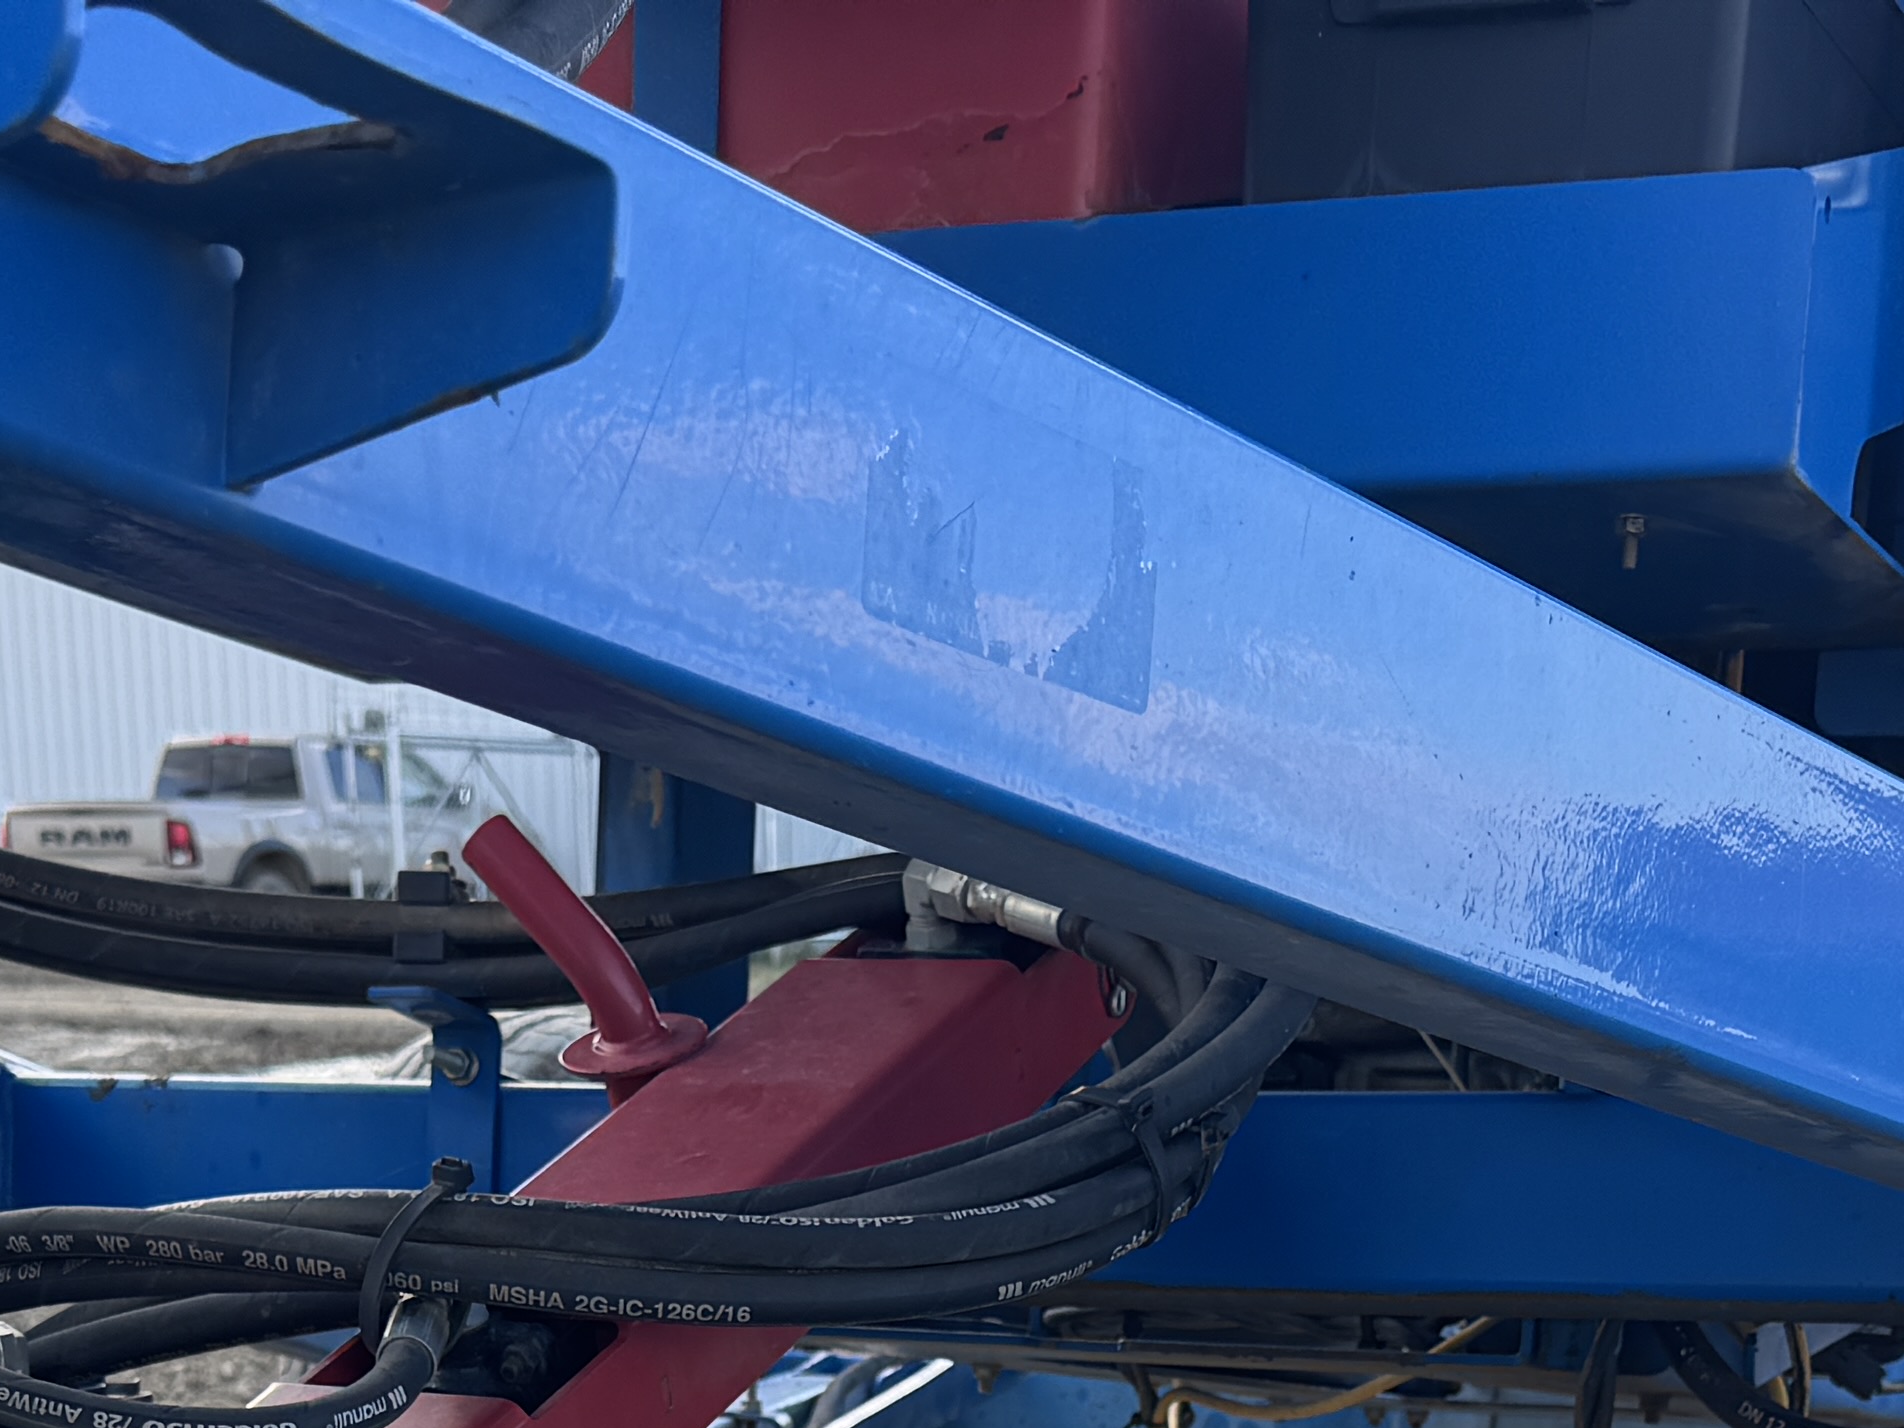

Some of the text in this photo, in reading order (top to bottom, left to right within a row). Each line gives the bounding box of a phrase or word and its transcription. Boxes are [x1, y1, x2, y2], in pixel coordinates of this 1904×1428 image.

[39, 823, 133, 847] RAM
[4, 1235, 32, 1254] -06
[40, 1234, 75, 1253] 3/8"
[95, 1234, 131, 1255] WP
[145, 1240, 183, 1260] 280
[187, 1242, 226, 1265] bar
[241, 1249, 289, 1273] 28.0
[295, 1256, 348, 1280] MPa
[430, 1277, 460, 1295] psi
[488, 1282, 566, 1311] MSHA
[574, 1295, 752, 1324] 2G-IC-126C/16
[16, 1260, 43, 1281] ISO
[1736, 1399, 1765, 1425] DN
